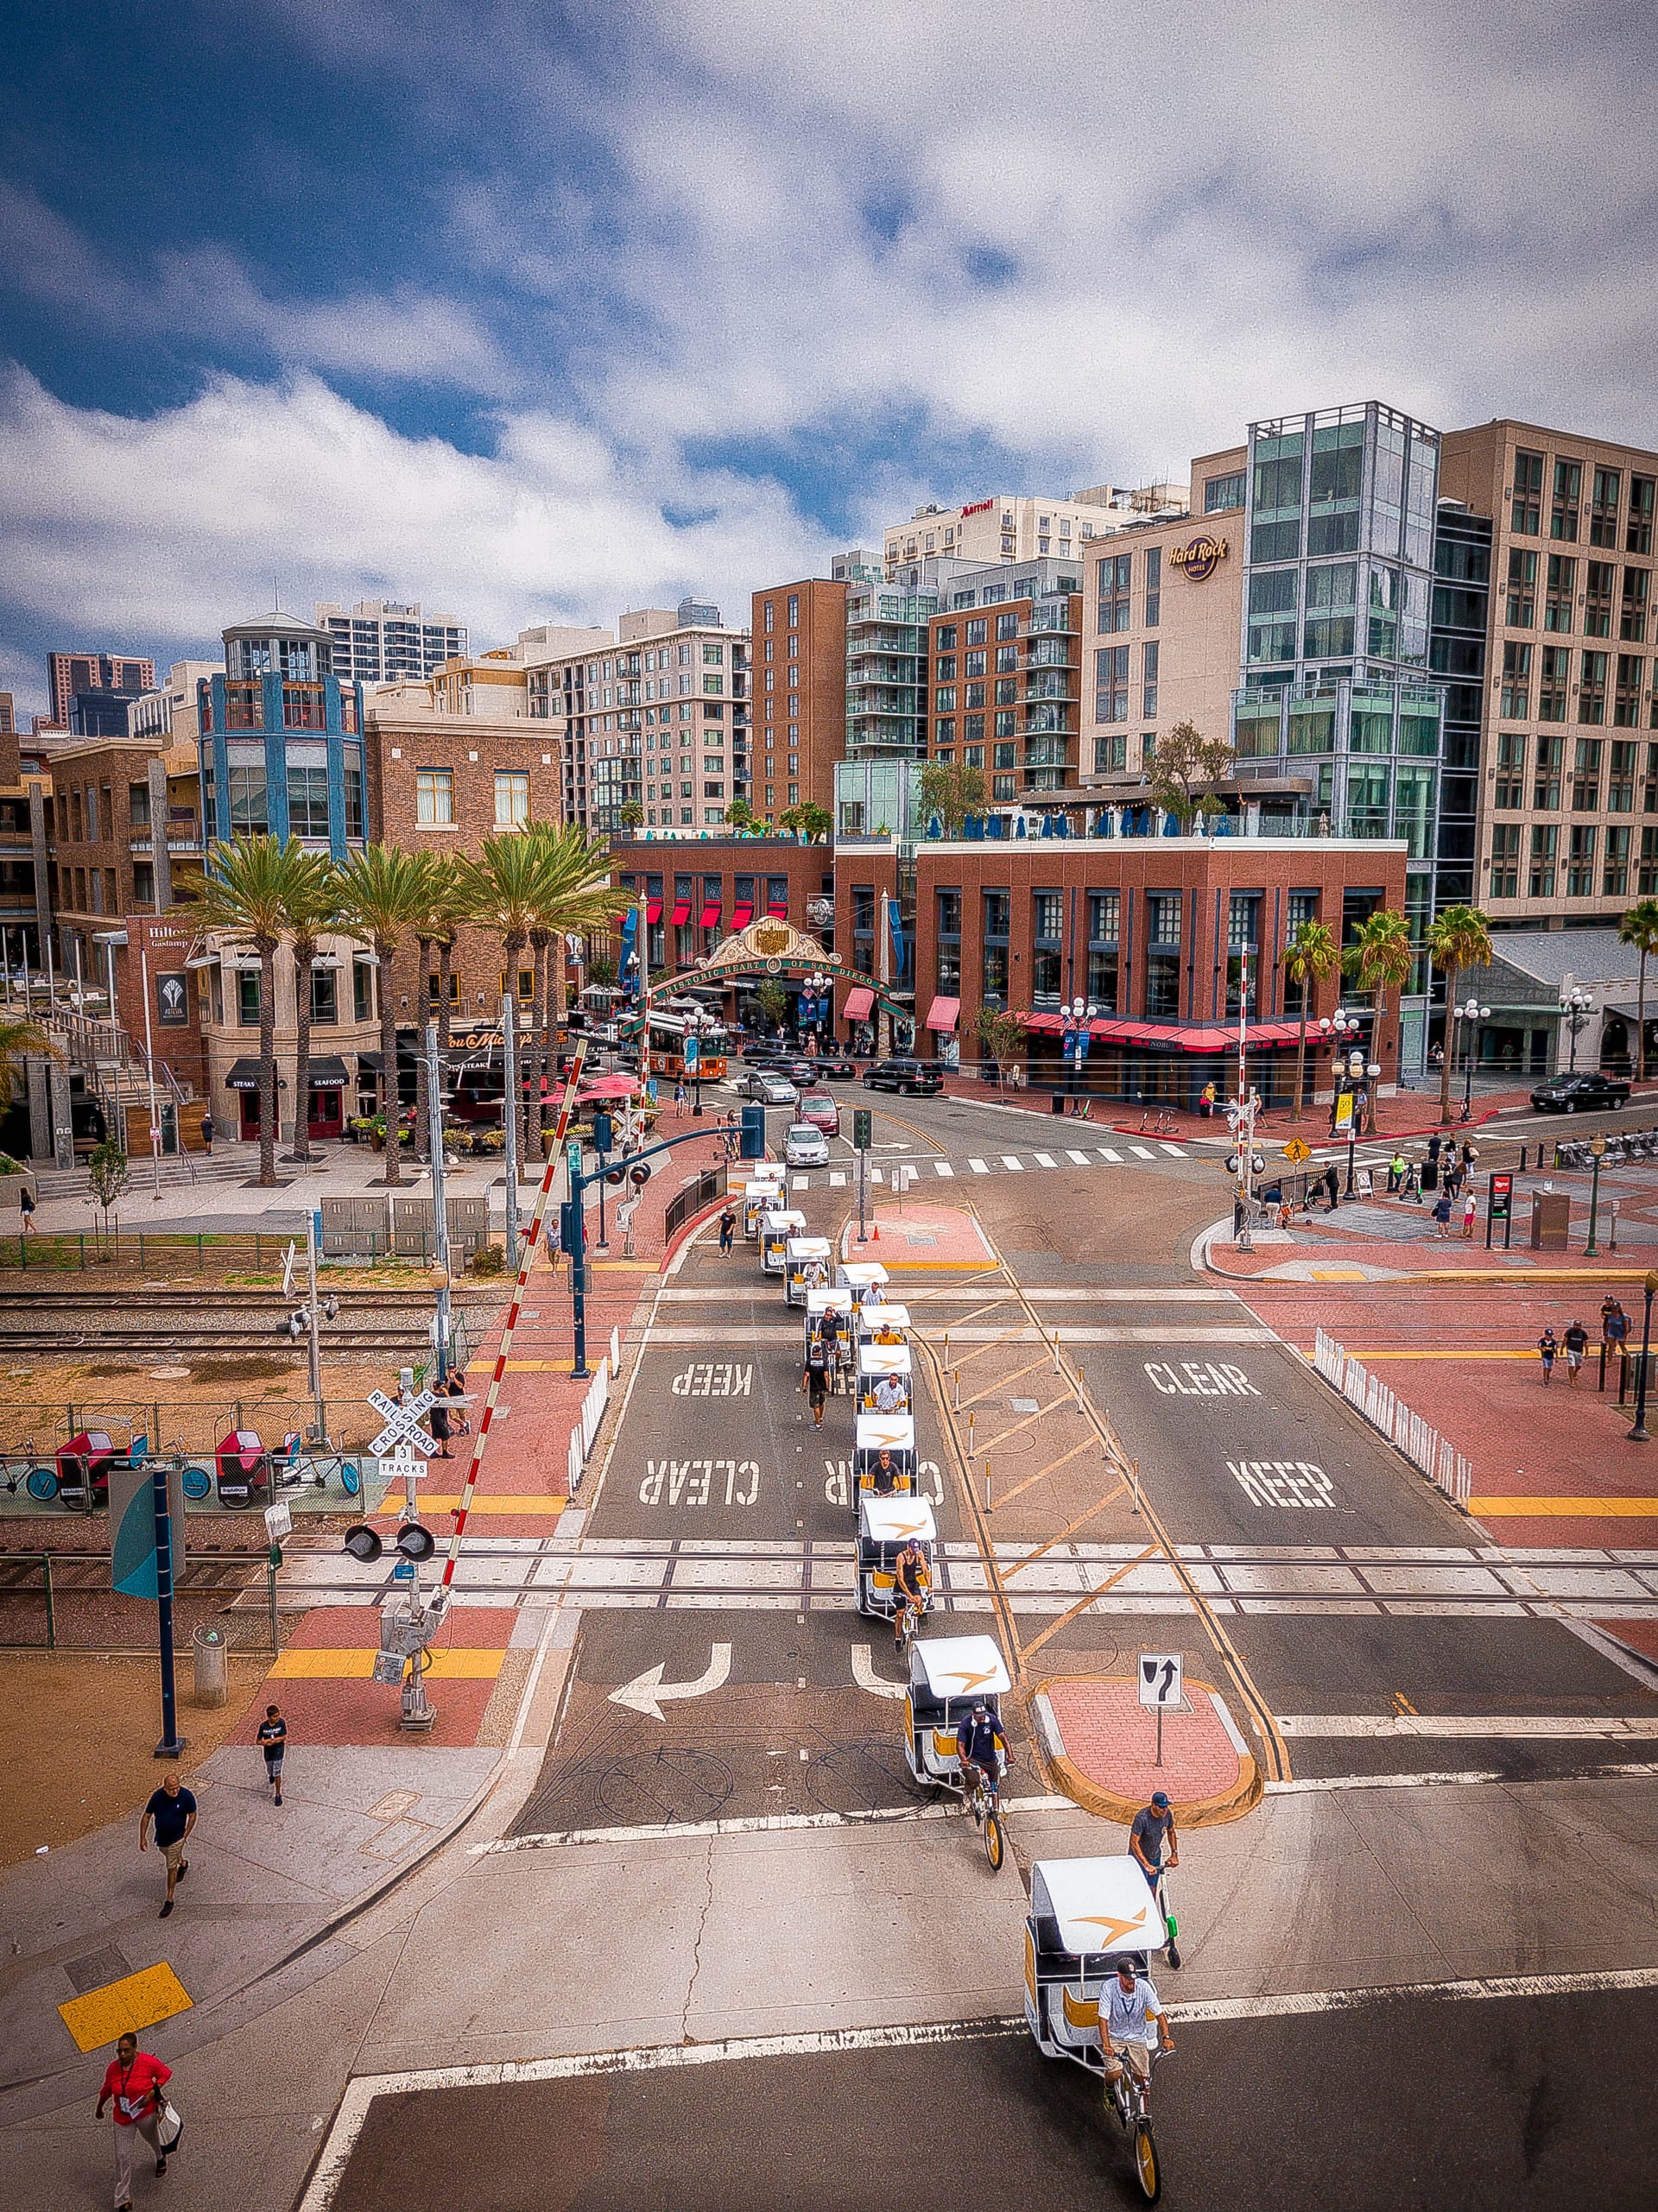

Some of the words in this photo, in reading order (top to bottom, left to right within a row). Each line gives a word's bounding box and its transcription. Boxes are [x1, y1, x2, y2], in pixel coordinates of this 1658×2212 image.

[1169, 544, 1198, 566] Hard
[1198, 538, 1226, 561] Rock
[1188, 564, 1206, 573] HOTEL
[151, 939, 188, 949] Gaslamp
[665, 969, 719, 995] HISTORIC
[724, 961, 760, 974] HEART
[811, 962, 832, 971] SAN
[838, 968, 873, 984] DIEGO
[670, 1363, 754, 1397] KEEP
[1142, 1362, 1262, 1396] CLEAR
[372, 1393, 433, 1453] CROSSING
[381, 1463, 425, 1473] TRACKS
[400, 1448, 407, 1458] 3
[637, 1459, 761, 1507] CLEAR
[1225, 1461, 1337, 1507] KEEP
